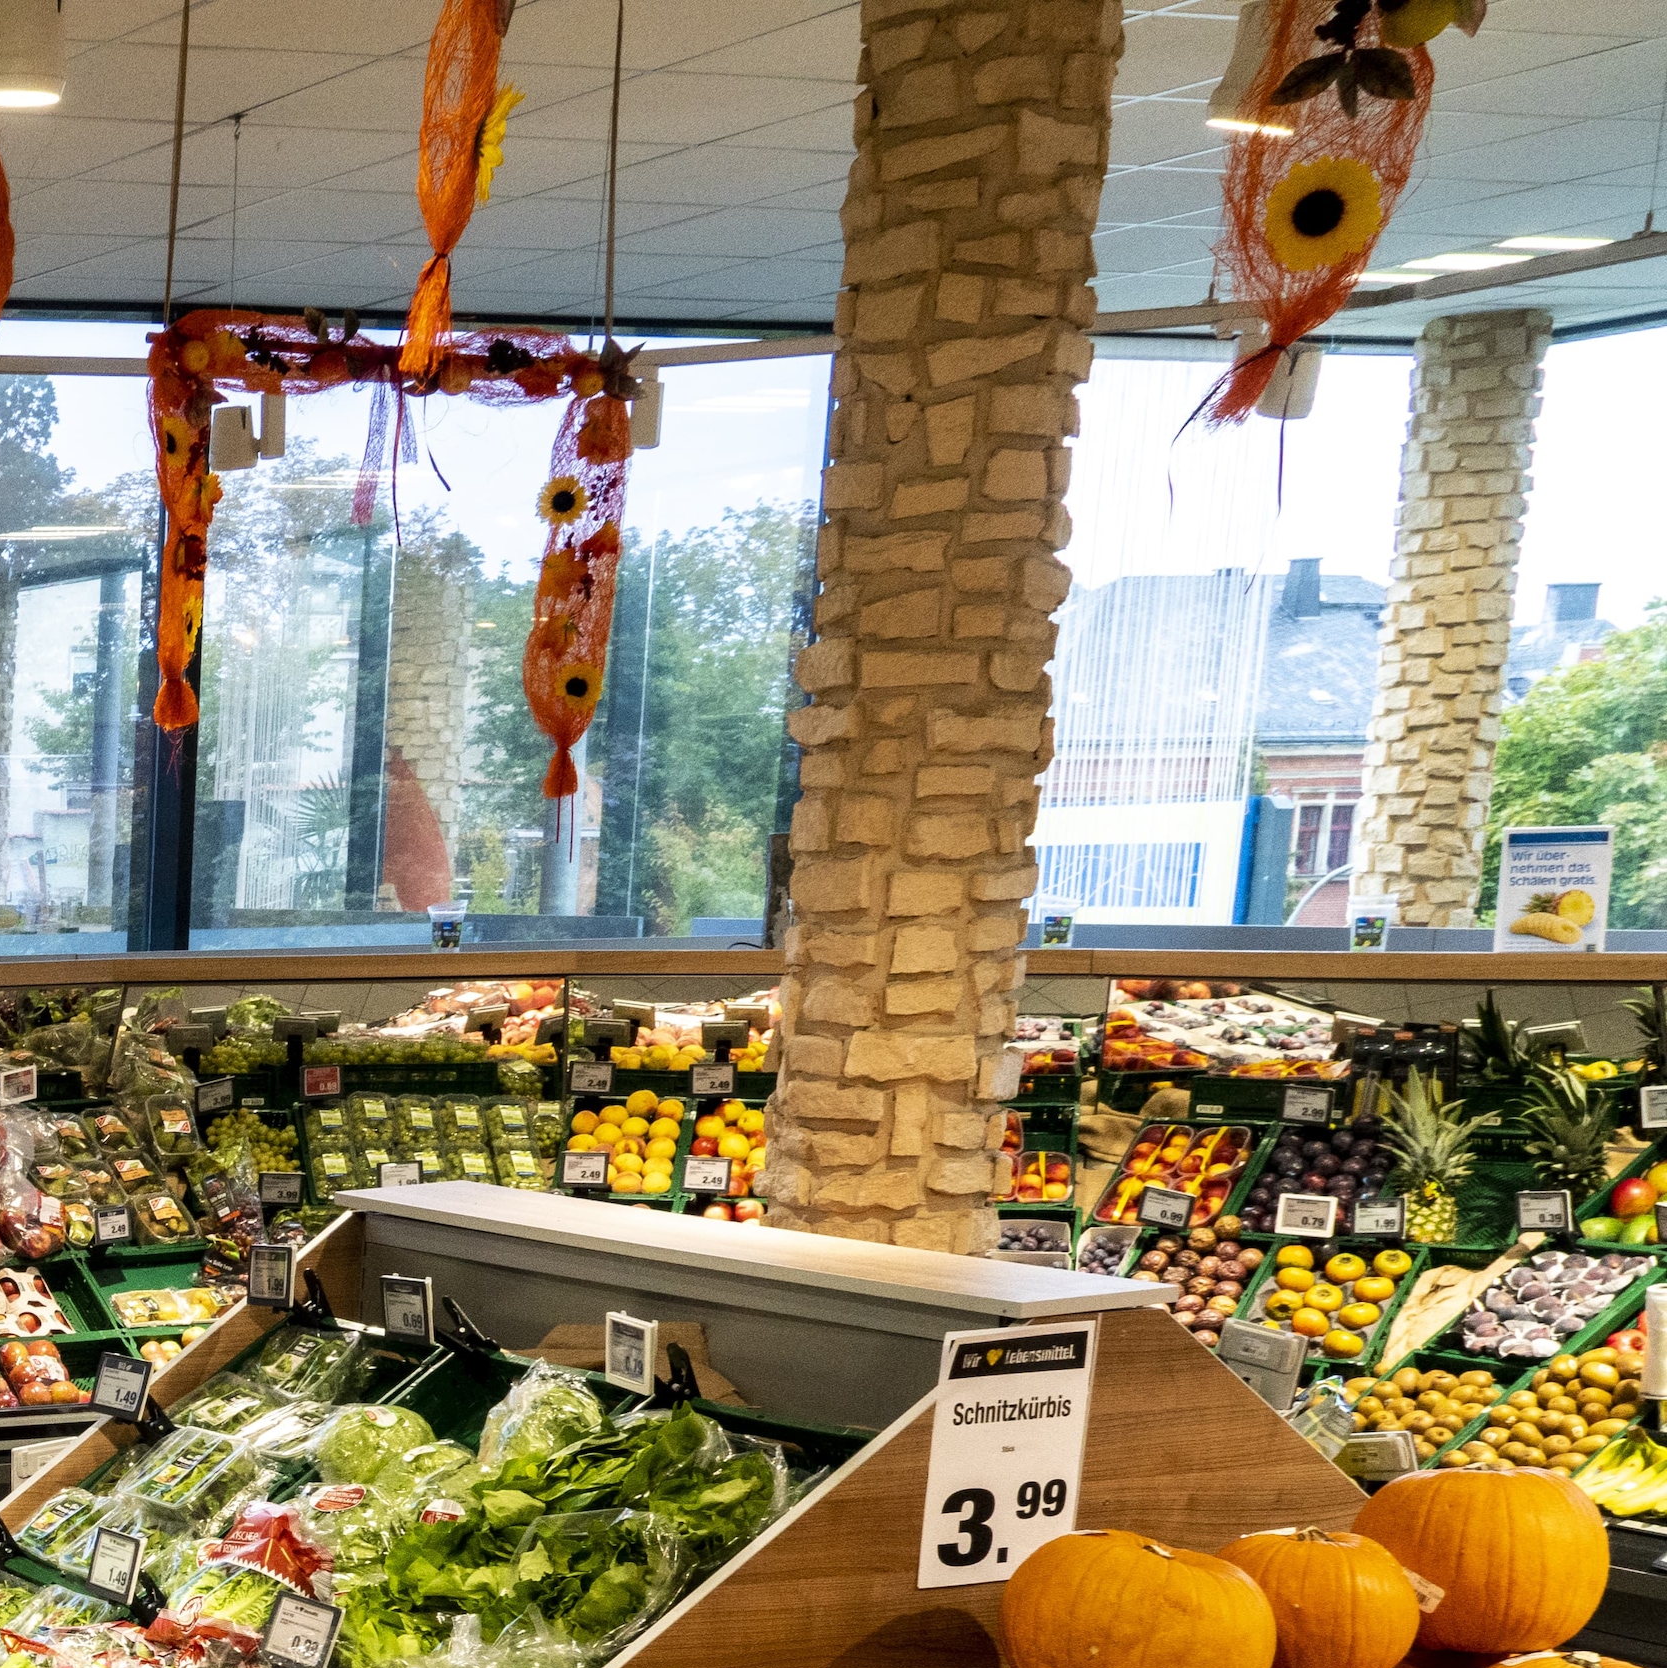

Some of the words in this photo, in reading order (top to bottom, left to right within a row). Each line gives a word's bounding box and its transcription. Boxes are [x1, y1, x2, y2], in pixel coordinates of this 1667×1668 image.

[1511, 851, 1532, 861] Wir
[1536, 851, 1570, 861] über-
[1510, 863, 1564, 874] nehmen
[1568, 863, 1592, 872] das
[1509, 875, 1556, 886] Schälen
[702, 1176, 722, 1184] 2.49
[277, 1191, 297, 1199] 3.99
[1160, 1210, 1183, 1221] 0.99
[1301, 1216, 1324, 1226] 0.79
[111, 1224, 126, 1233] 2.49
[267, 1277, 283, 1292] 1.99
[962, 1353, 982, 1369] Wir
[1005, 1344, 1076, 1365] Lebensmittel.
[114, 1388, 137, 1404] 1.49
[953, 1395, 1072, 1426] Schnitzkürbis
[108, 1567, 128, 1586] 1.49
